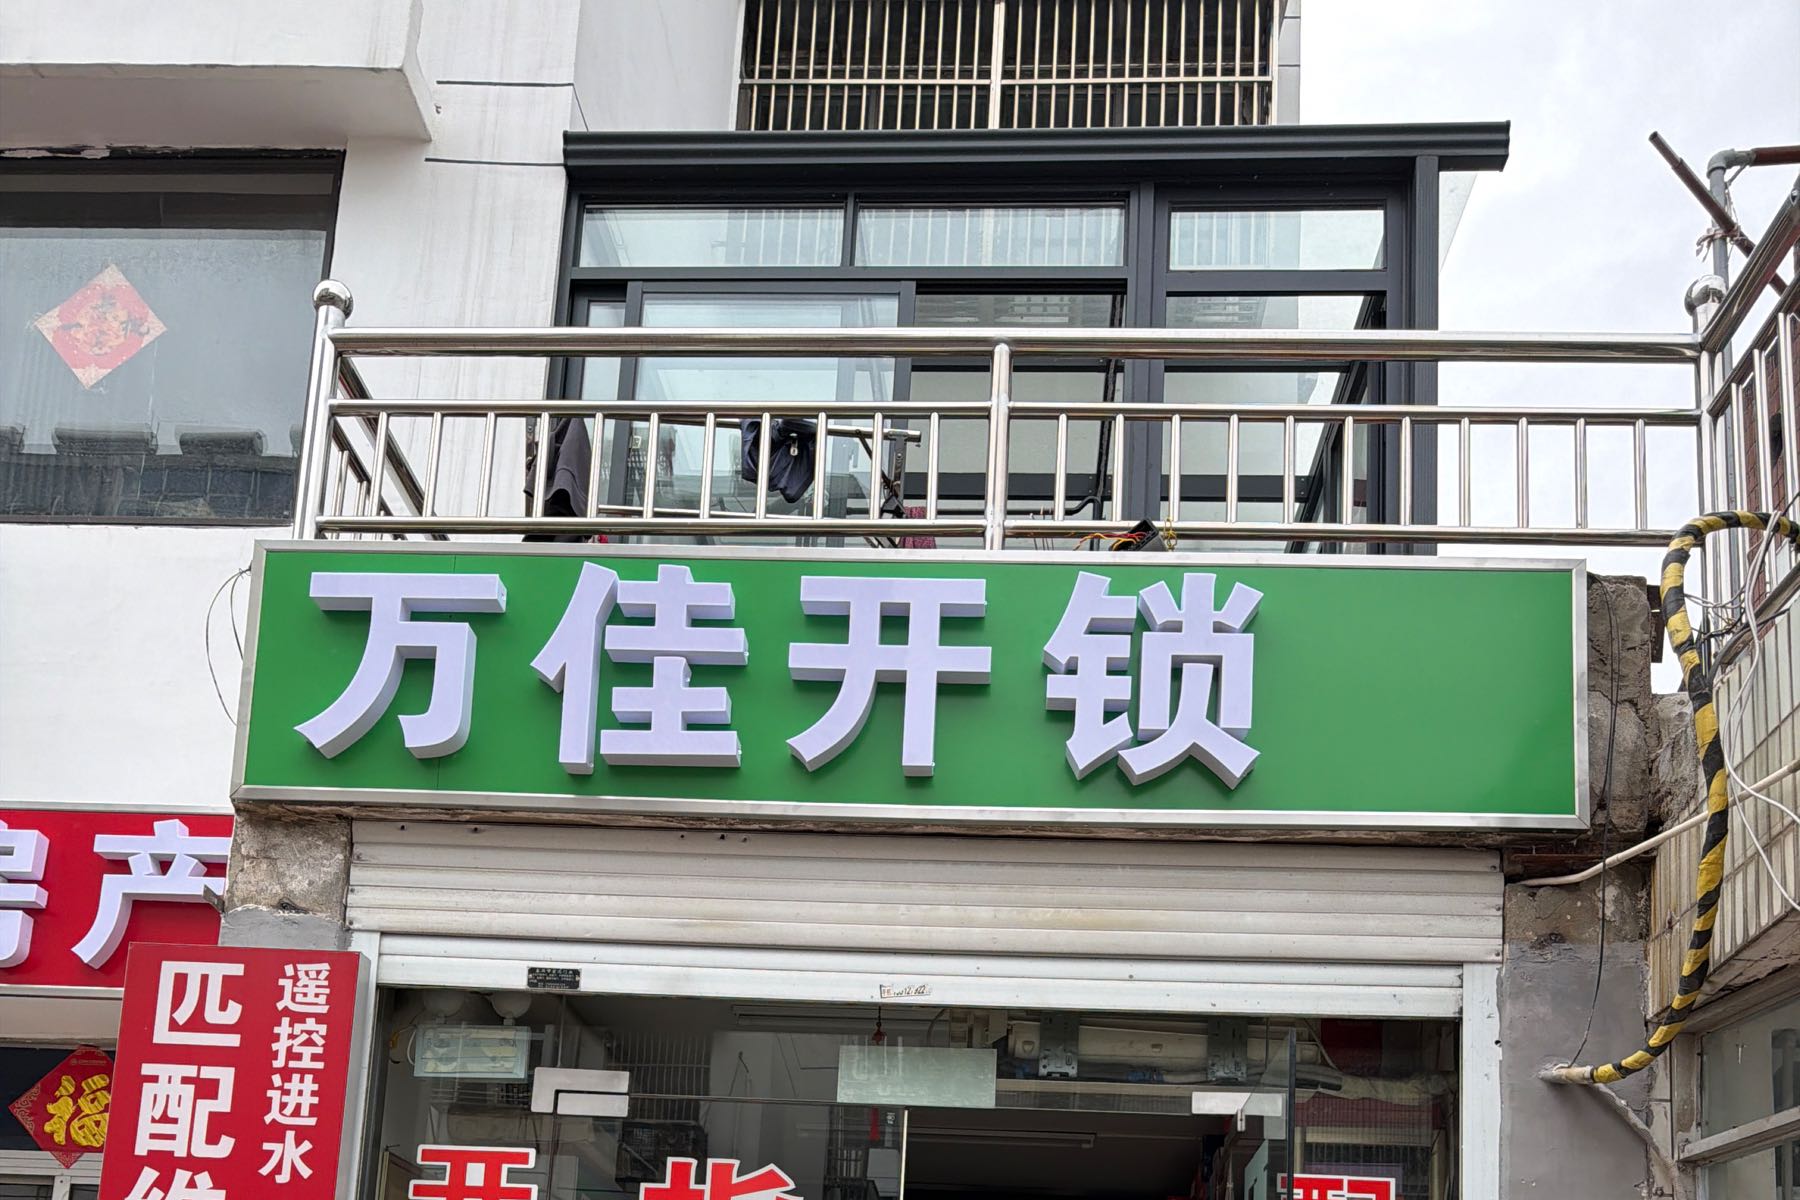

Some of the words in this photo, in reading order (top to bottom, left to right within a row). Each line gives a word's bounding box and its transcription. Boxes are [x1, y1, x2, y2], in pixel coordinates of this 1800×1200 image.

[294, 560, 1265, 790] 万佳开锁
[44, 1073, 111, 1148] 福
[258, 962, 332, 1185] 遥控进水
